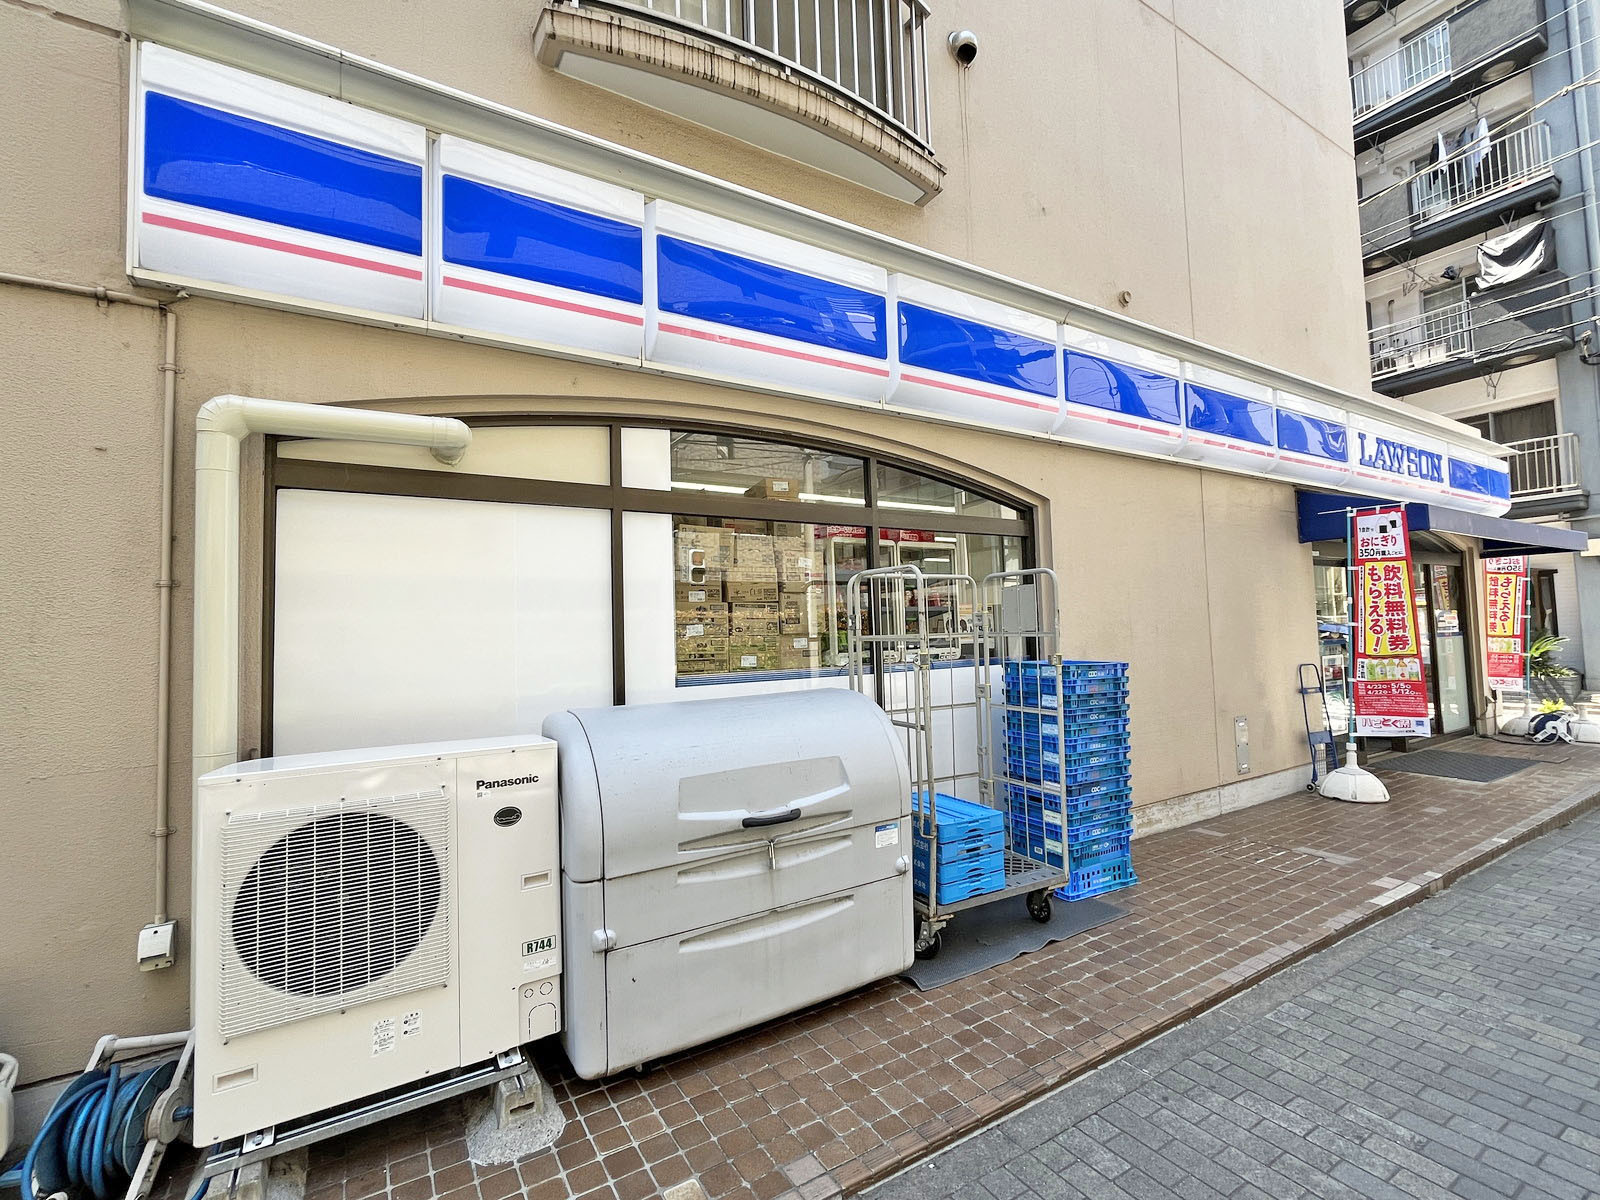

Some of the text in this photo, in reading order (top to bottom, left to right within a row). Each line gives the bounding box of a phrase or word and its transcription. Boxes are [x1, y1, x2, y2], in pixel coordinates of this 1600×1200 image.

[1358, 432, 1444, 483] LAWSON
[1360, 534, 1397, 548] おにぎり
[1383, 564, 1410, 651] 飲料無料券
[476, 774, 540, 790] Panasonic
[526, 937, 552, 954] R744
